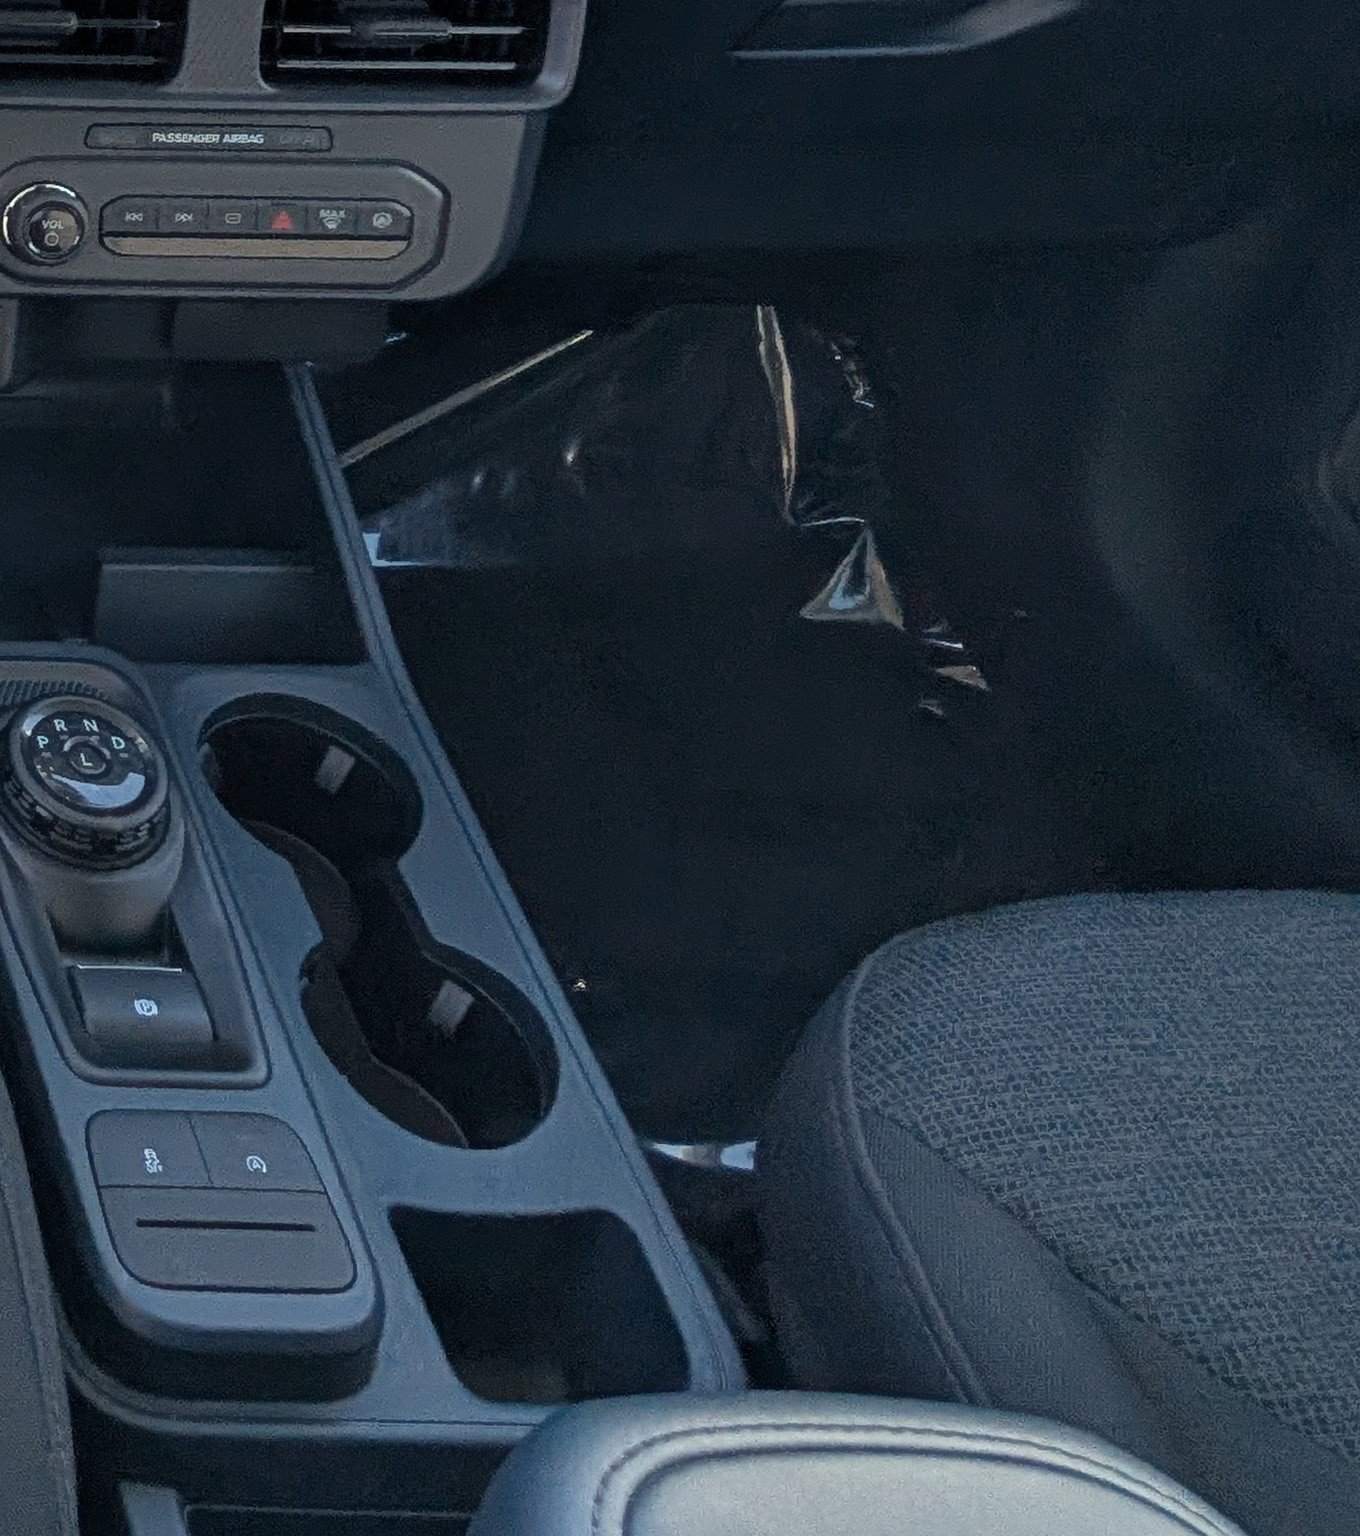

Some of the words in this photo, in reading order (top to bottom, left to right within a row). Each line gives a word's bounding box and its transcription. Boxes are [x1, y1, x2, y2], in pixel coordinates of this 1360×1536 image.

[151, 132, 220, 144] PASSENGER
[222, 133, 265, 144] AIRBAG
[42, 219, 64, 230] VOL
[54, 719, 67, 732] R
[83, 719, 99, 732] N
[37, 736, 49, 749] P
[111, 736, 125, 749] D
[81, 753, 93, 766] L
